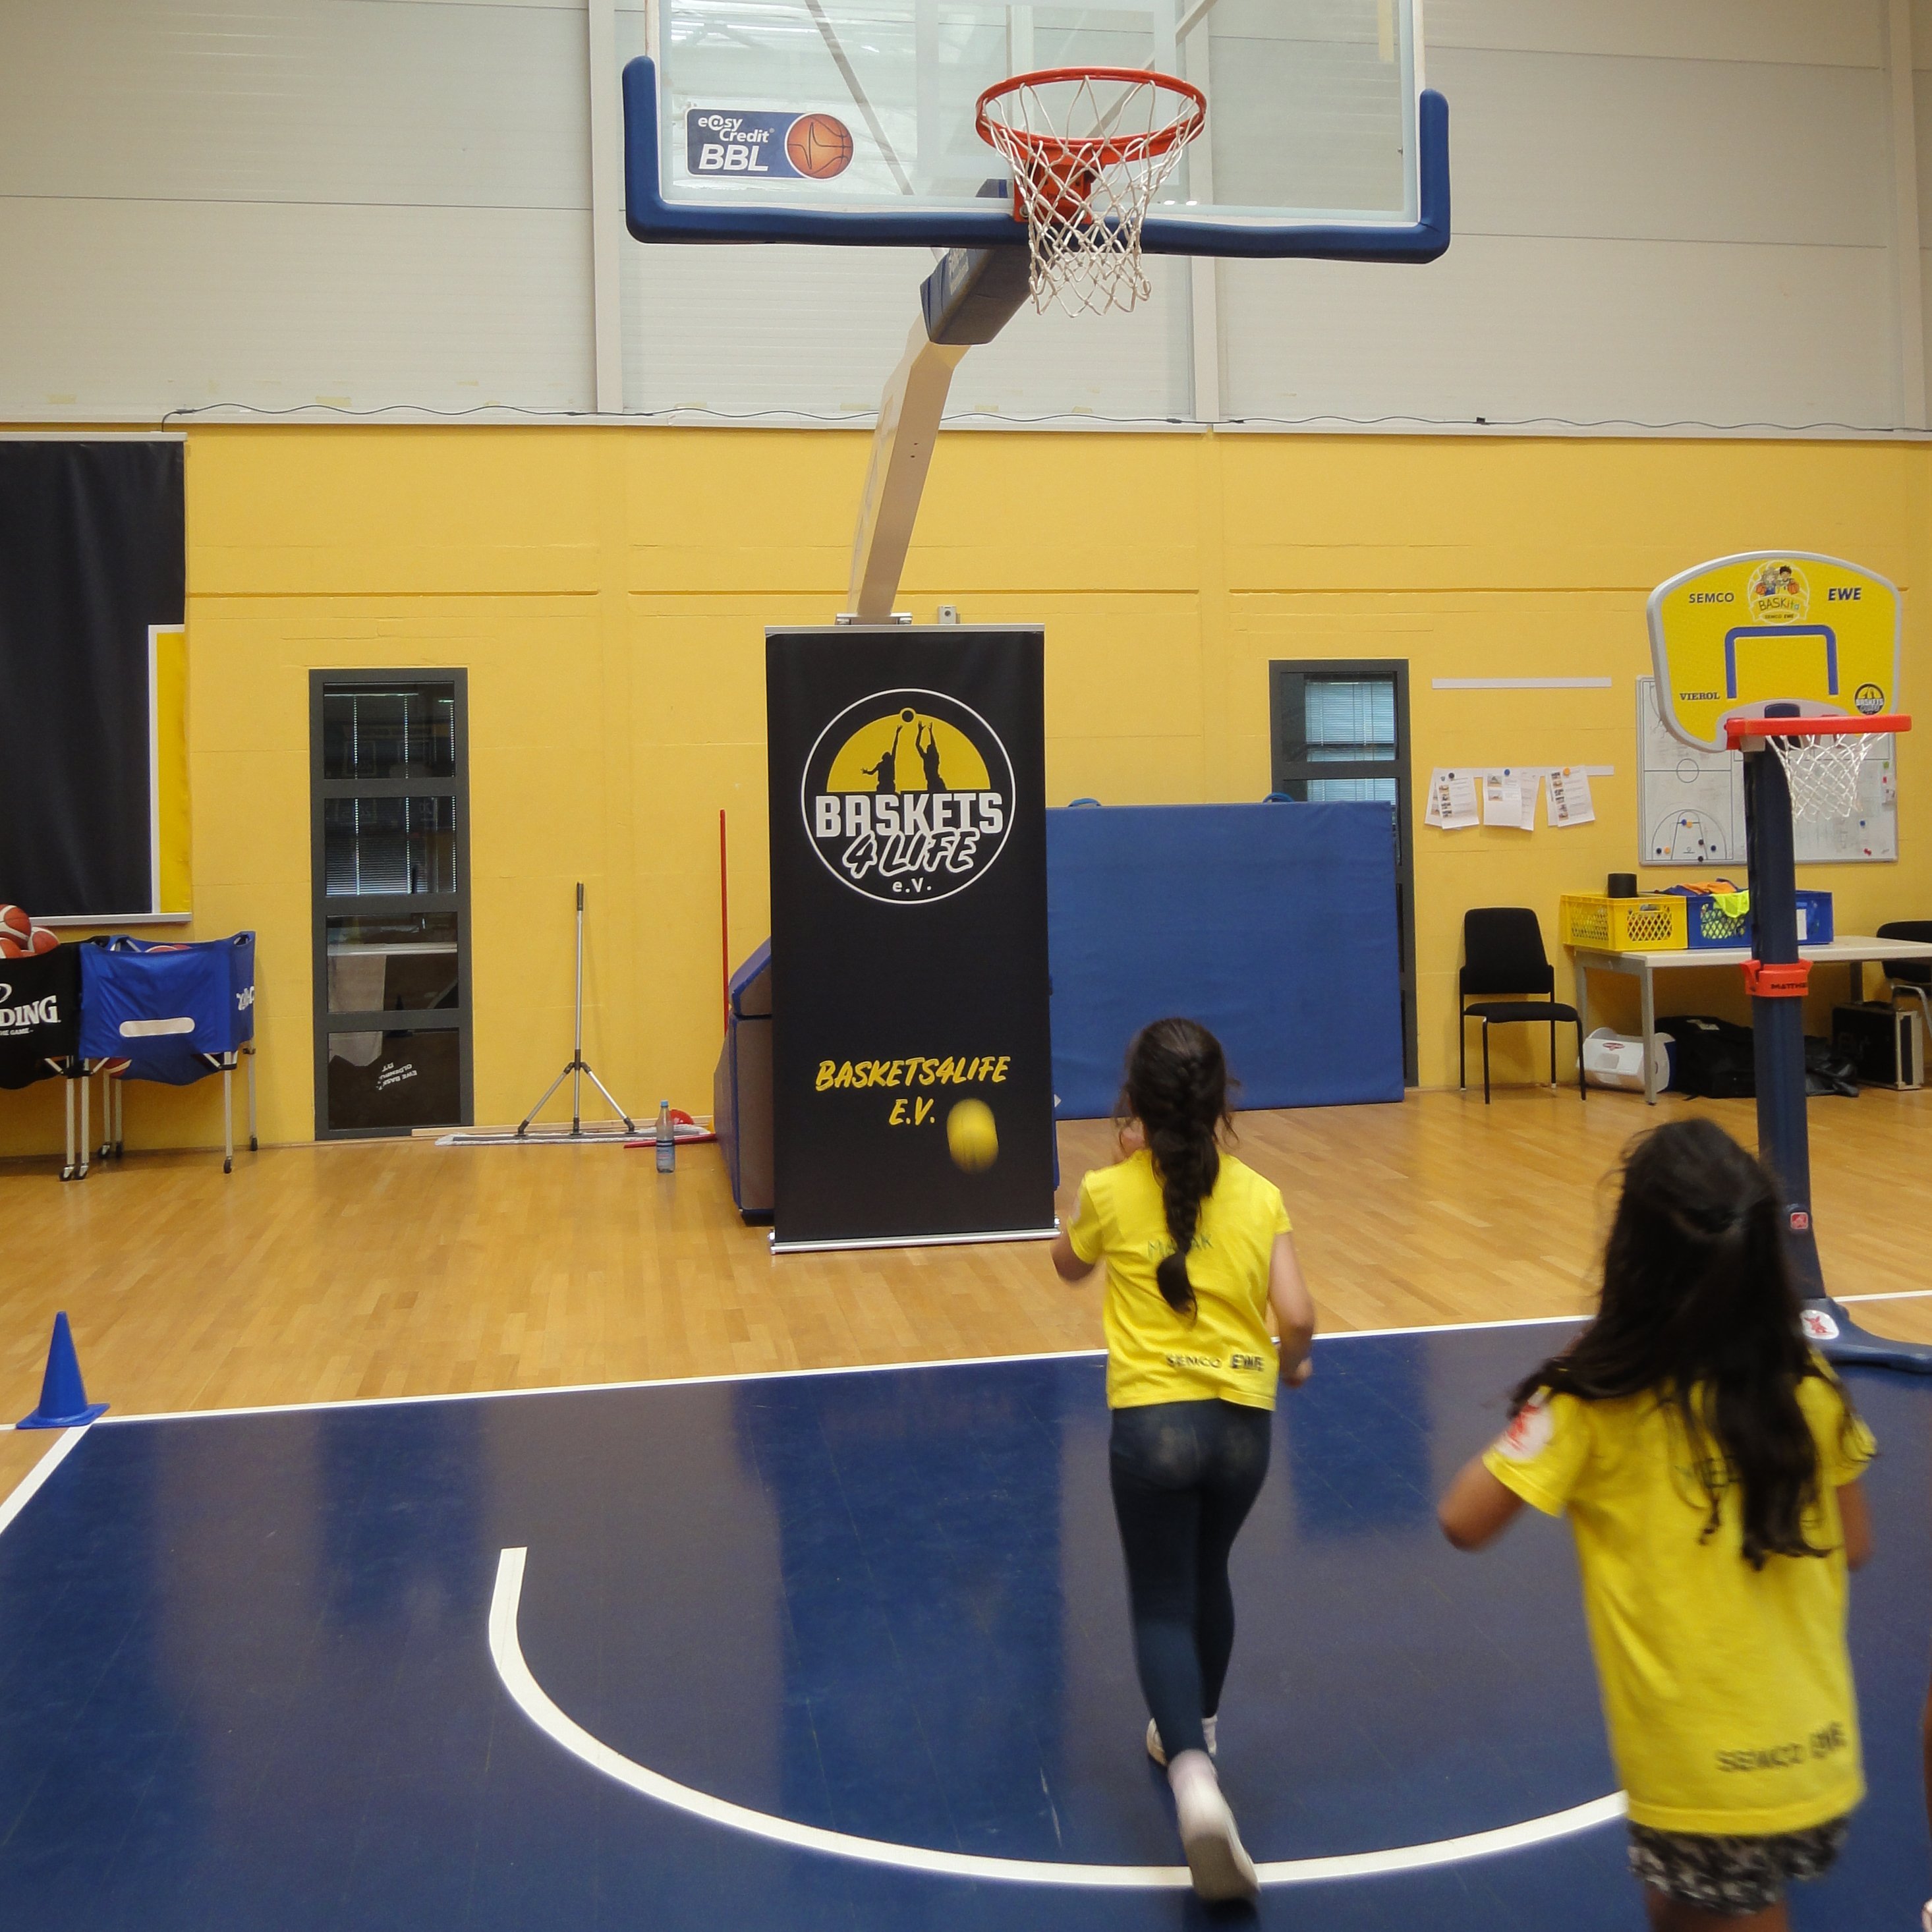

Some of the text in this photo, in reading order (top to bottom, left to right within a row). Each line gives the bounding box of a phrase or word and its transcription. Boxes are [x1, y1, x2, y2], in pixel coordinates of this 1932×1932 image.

[698, 144, 768, 171] BBL
[1689, 592, 1734, 604] SEMCO
[1828, 587, 1861, 601] EWE
[1679, 692, 1720, 700] VIEROL
[816, 793, 1003, 838] BASKETS
[892, 877, 932, 893] e.V.
[816, 1056, 1011, 1091] BASKETS4LIFE
[889, 1096, 935, 1125] E.V.
[1230, 1354, 1264, 1371] EWE
